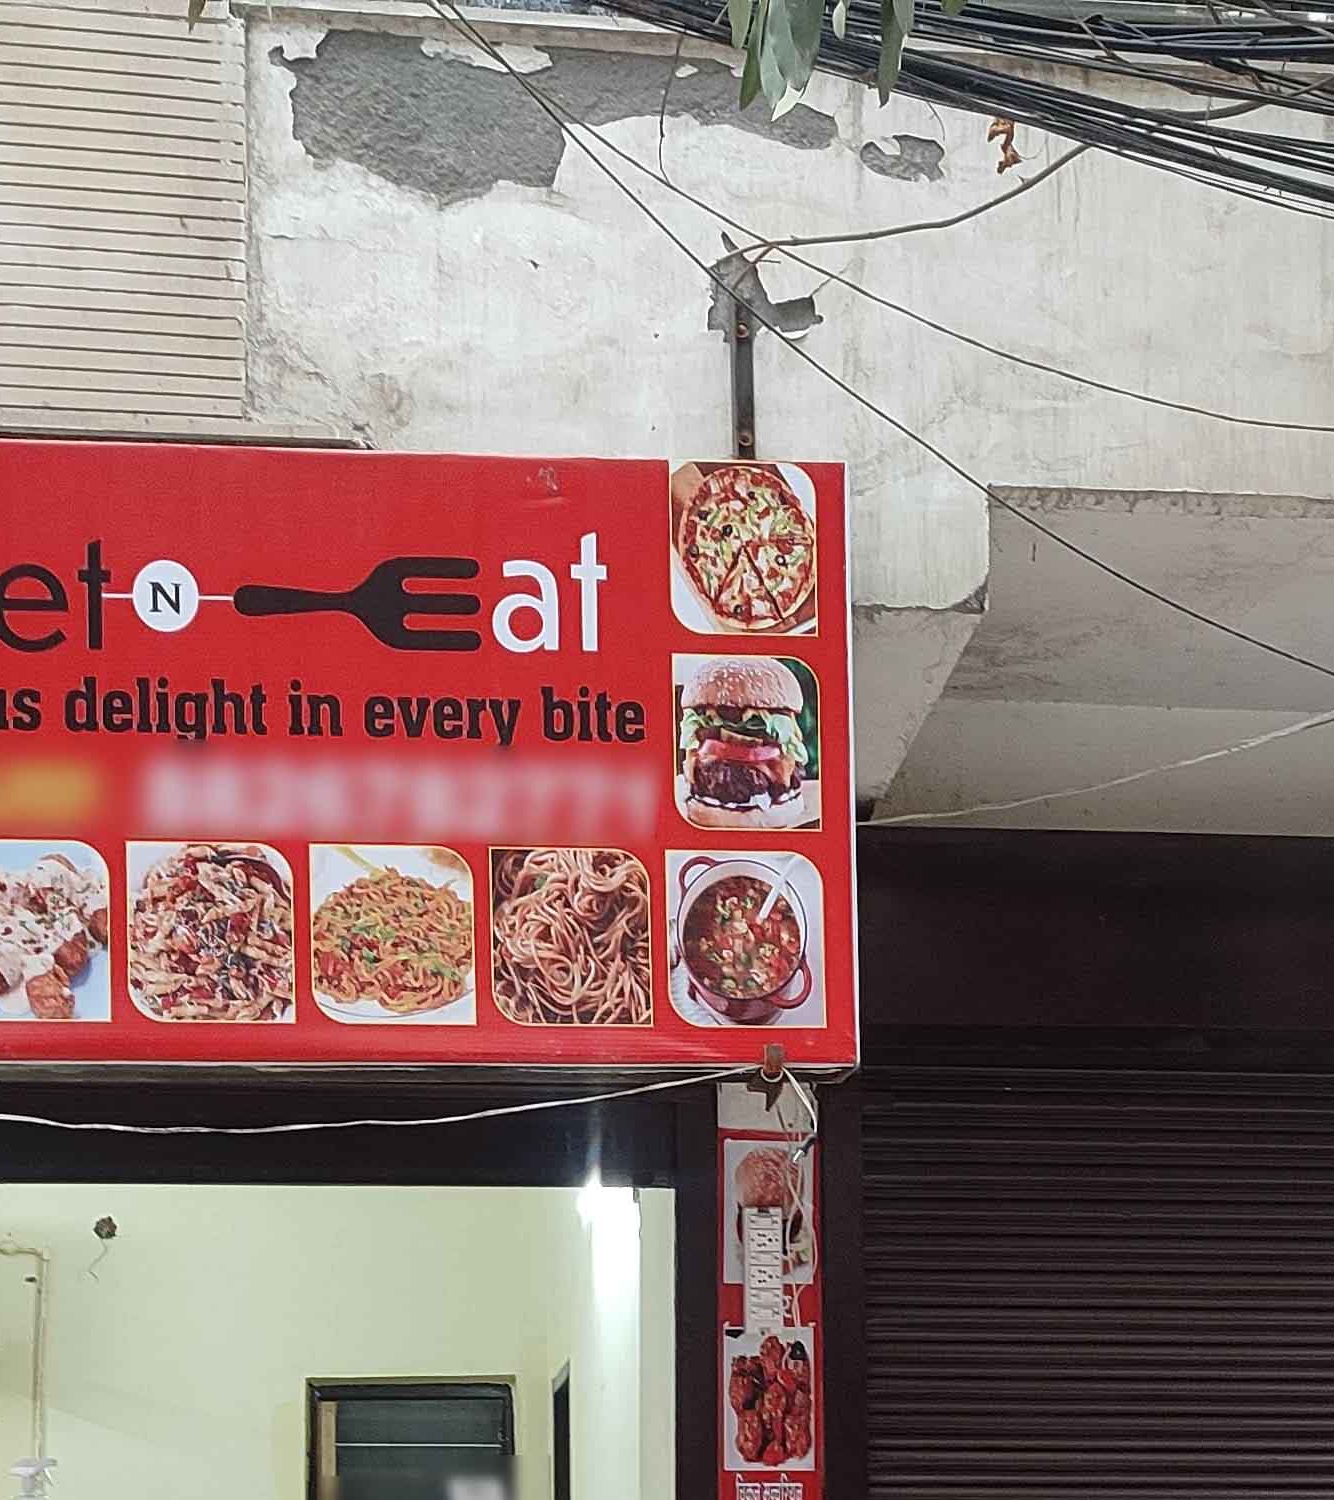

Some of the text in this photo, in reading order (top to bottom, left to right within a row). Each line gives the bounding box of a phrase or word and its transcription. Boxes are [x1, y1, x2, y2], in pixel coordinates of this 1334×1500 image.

[65, 676, 268, 741] delight
[288, 680, 342, 737] in
[364, 692, 520, 747] every
[542, 685, 645, 743] bite
